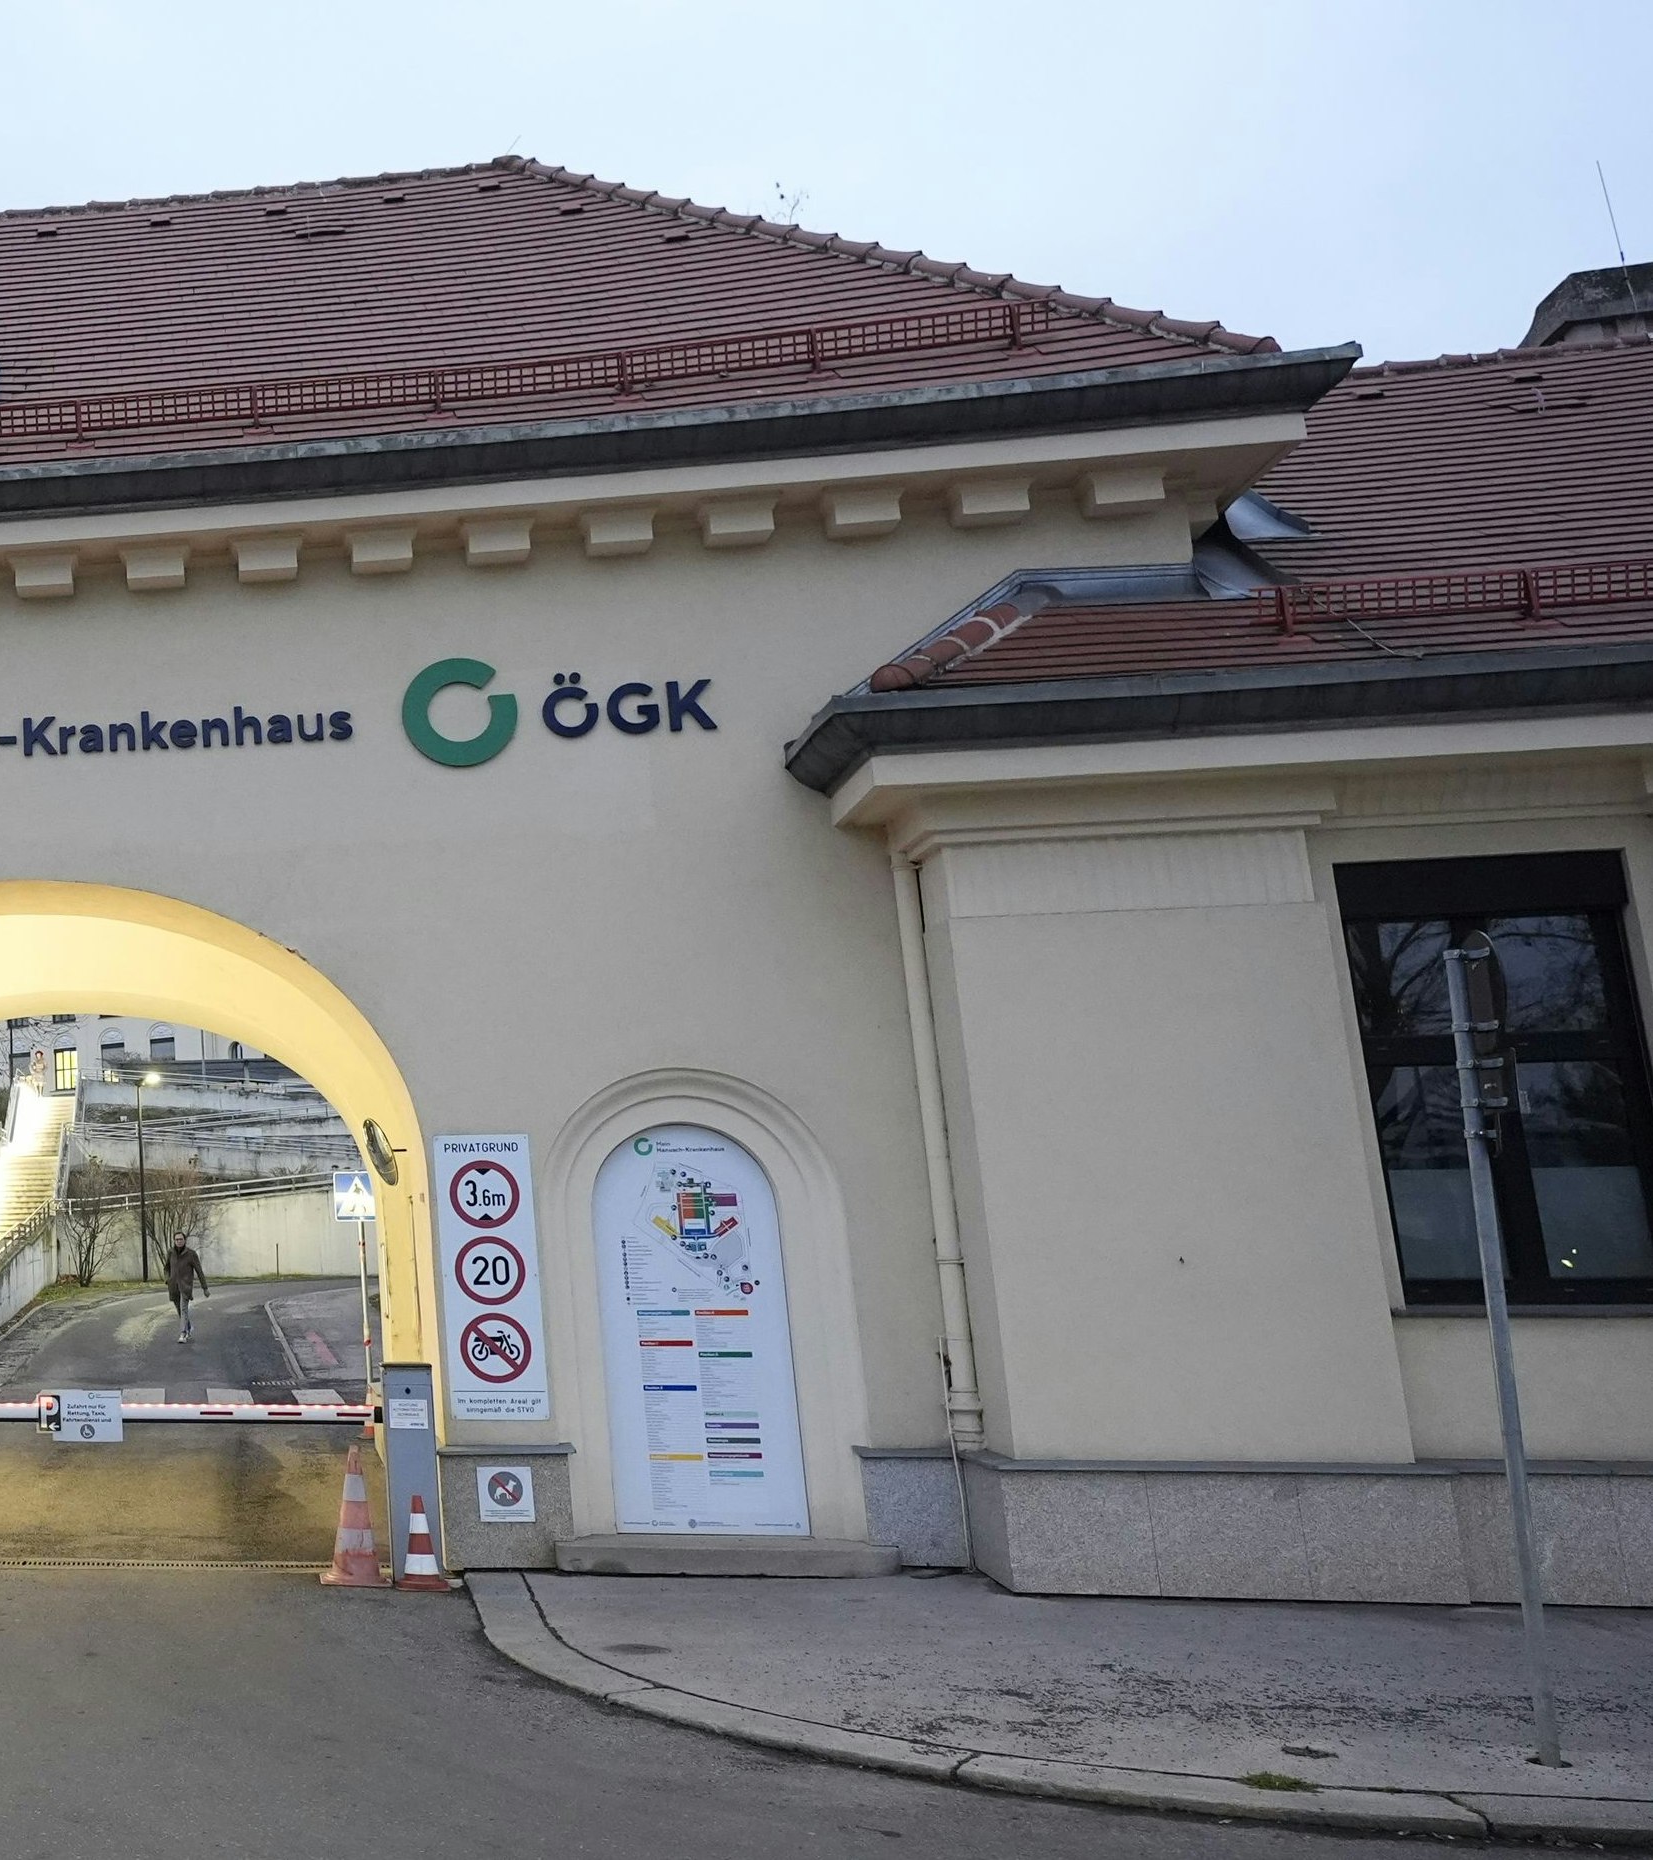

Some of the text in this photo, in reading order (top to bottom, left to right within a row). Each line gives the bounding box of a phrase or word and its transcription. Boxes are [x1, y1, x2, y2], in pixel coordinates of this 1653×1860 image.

[542, 672, 718, 739] ÖGK
[443, 1142, 519, 1154] PRIVATGRUND
[464, 1179, 506, 1207] 3.6m
[471, 1255, 510, 1286] 20
